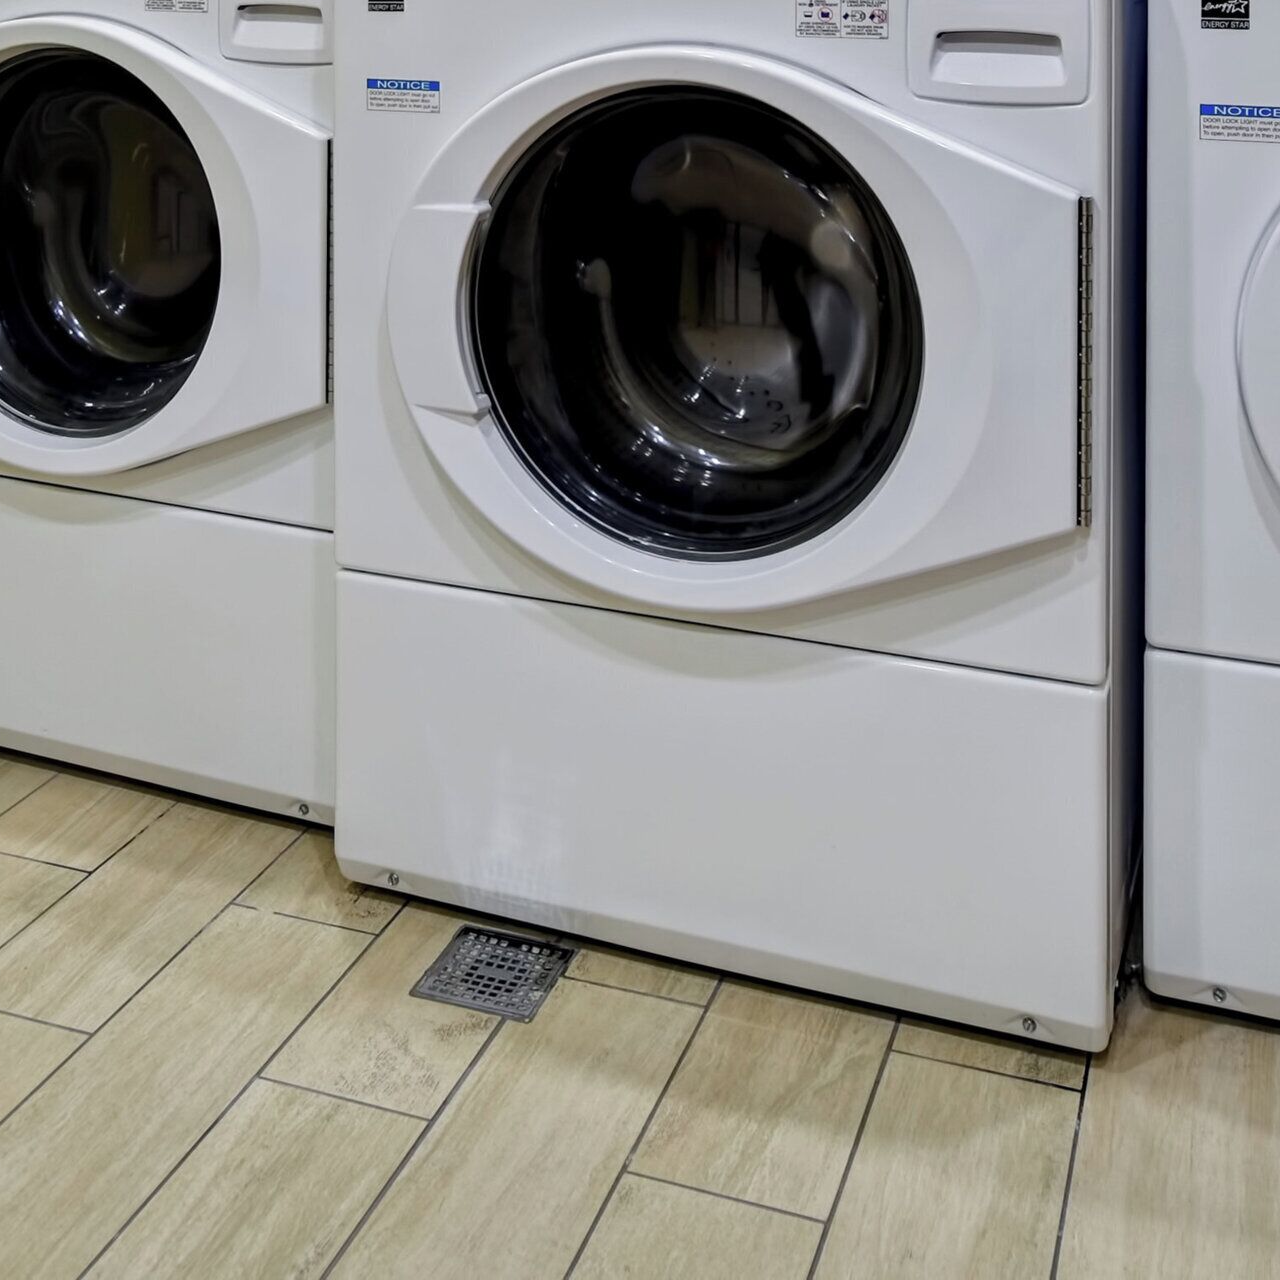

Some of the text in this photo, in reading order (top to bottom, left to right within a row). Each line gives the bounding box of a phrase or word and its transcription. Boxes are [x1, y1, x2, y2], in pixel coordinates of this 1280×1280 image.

[1202, 21, 1250, 29] ENERGY STAR
[377, 80, 430, 90] NOTICE
